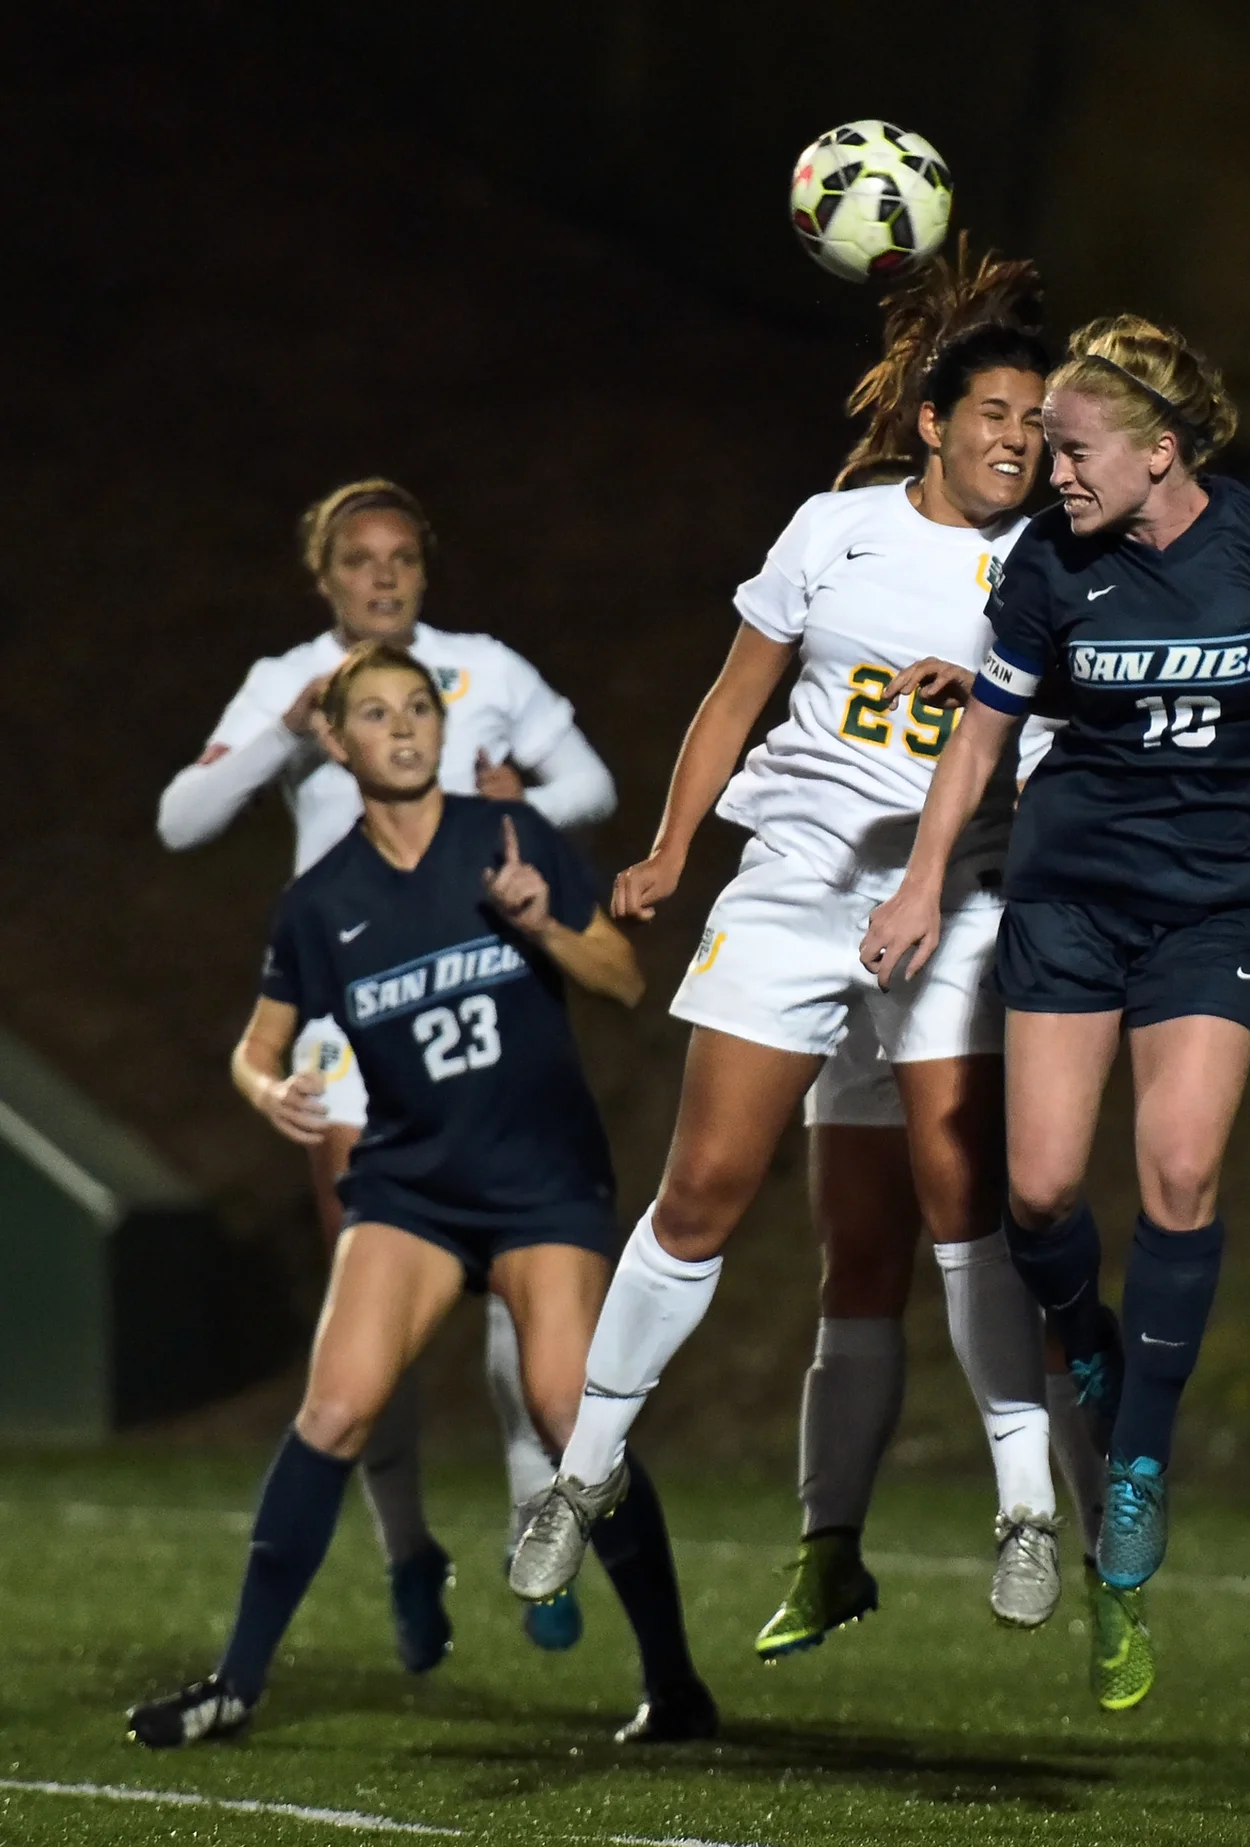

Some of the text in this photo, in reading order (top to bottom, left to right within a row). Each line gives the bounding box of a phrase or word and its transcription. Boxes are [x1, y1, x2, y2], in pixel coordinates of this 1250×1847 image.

[1073, 644, 1152, 682] SAN
[839, 663, 958, 761] 29
[1135, 694, 1223, 749] 10
[353, 966, 429, 1020] SAN
[412, 993, 502, 1082] 23
